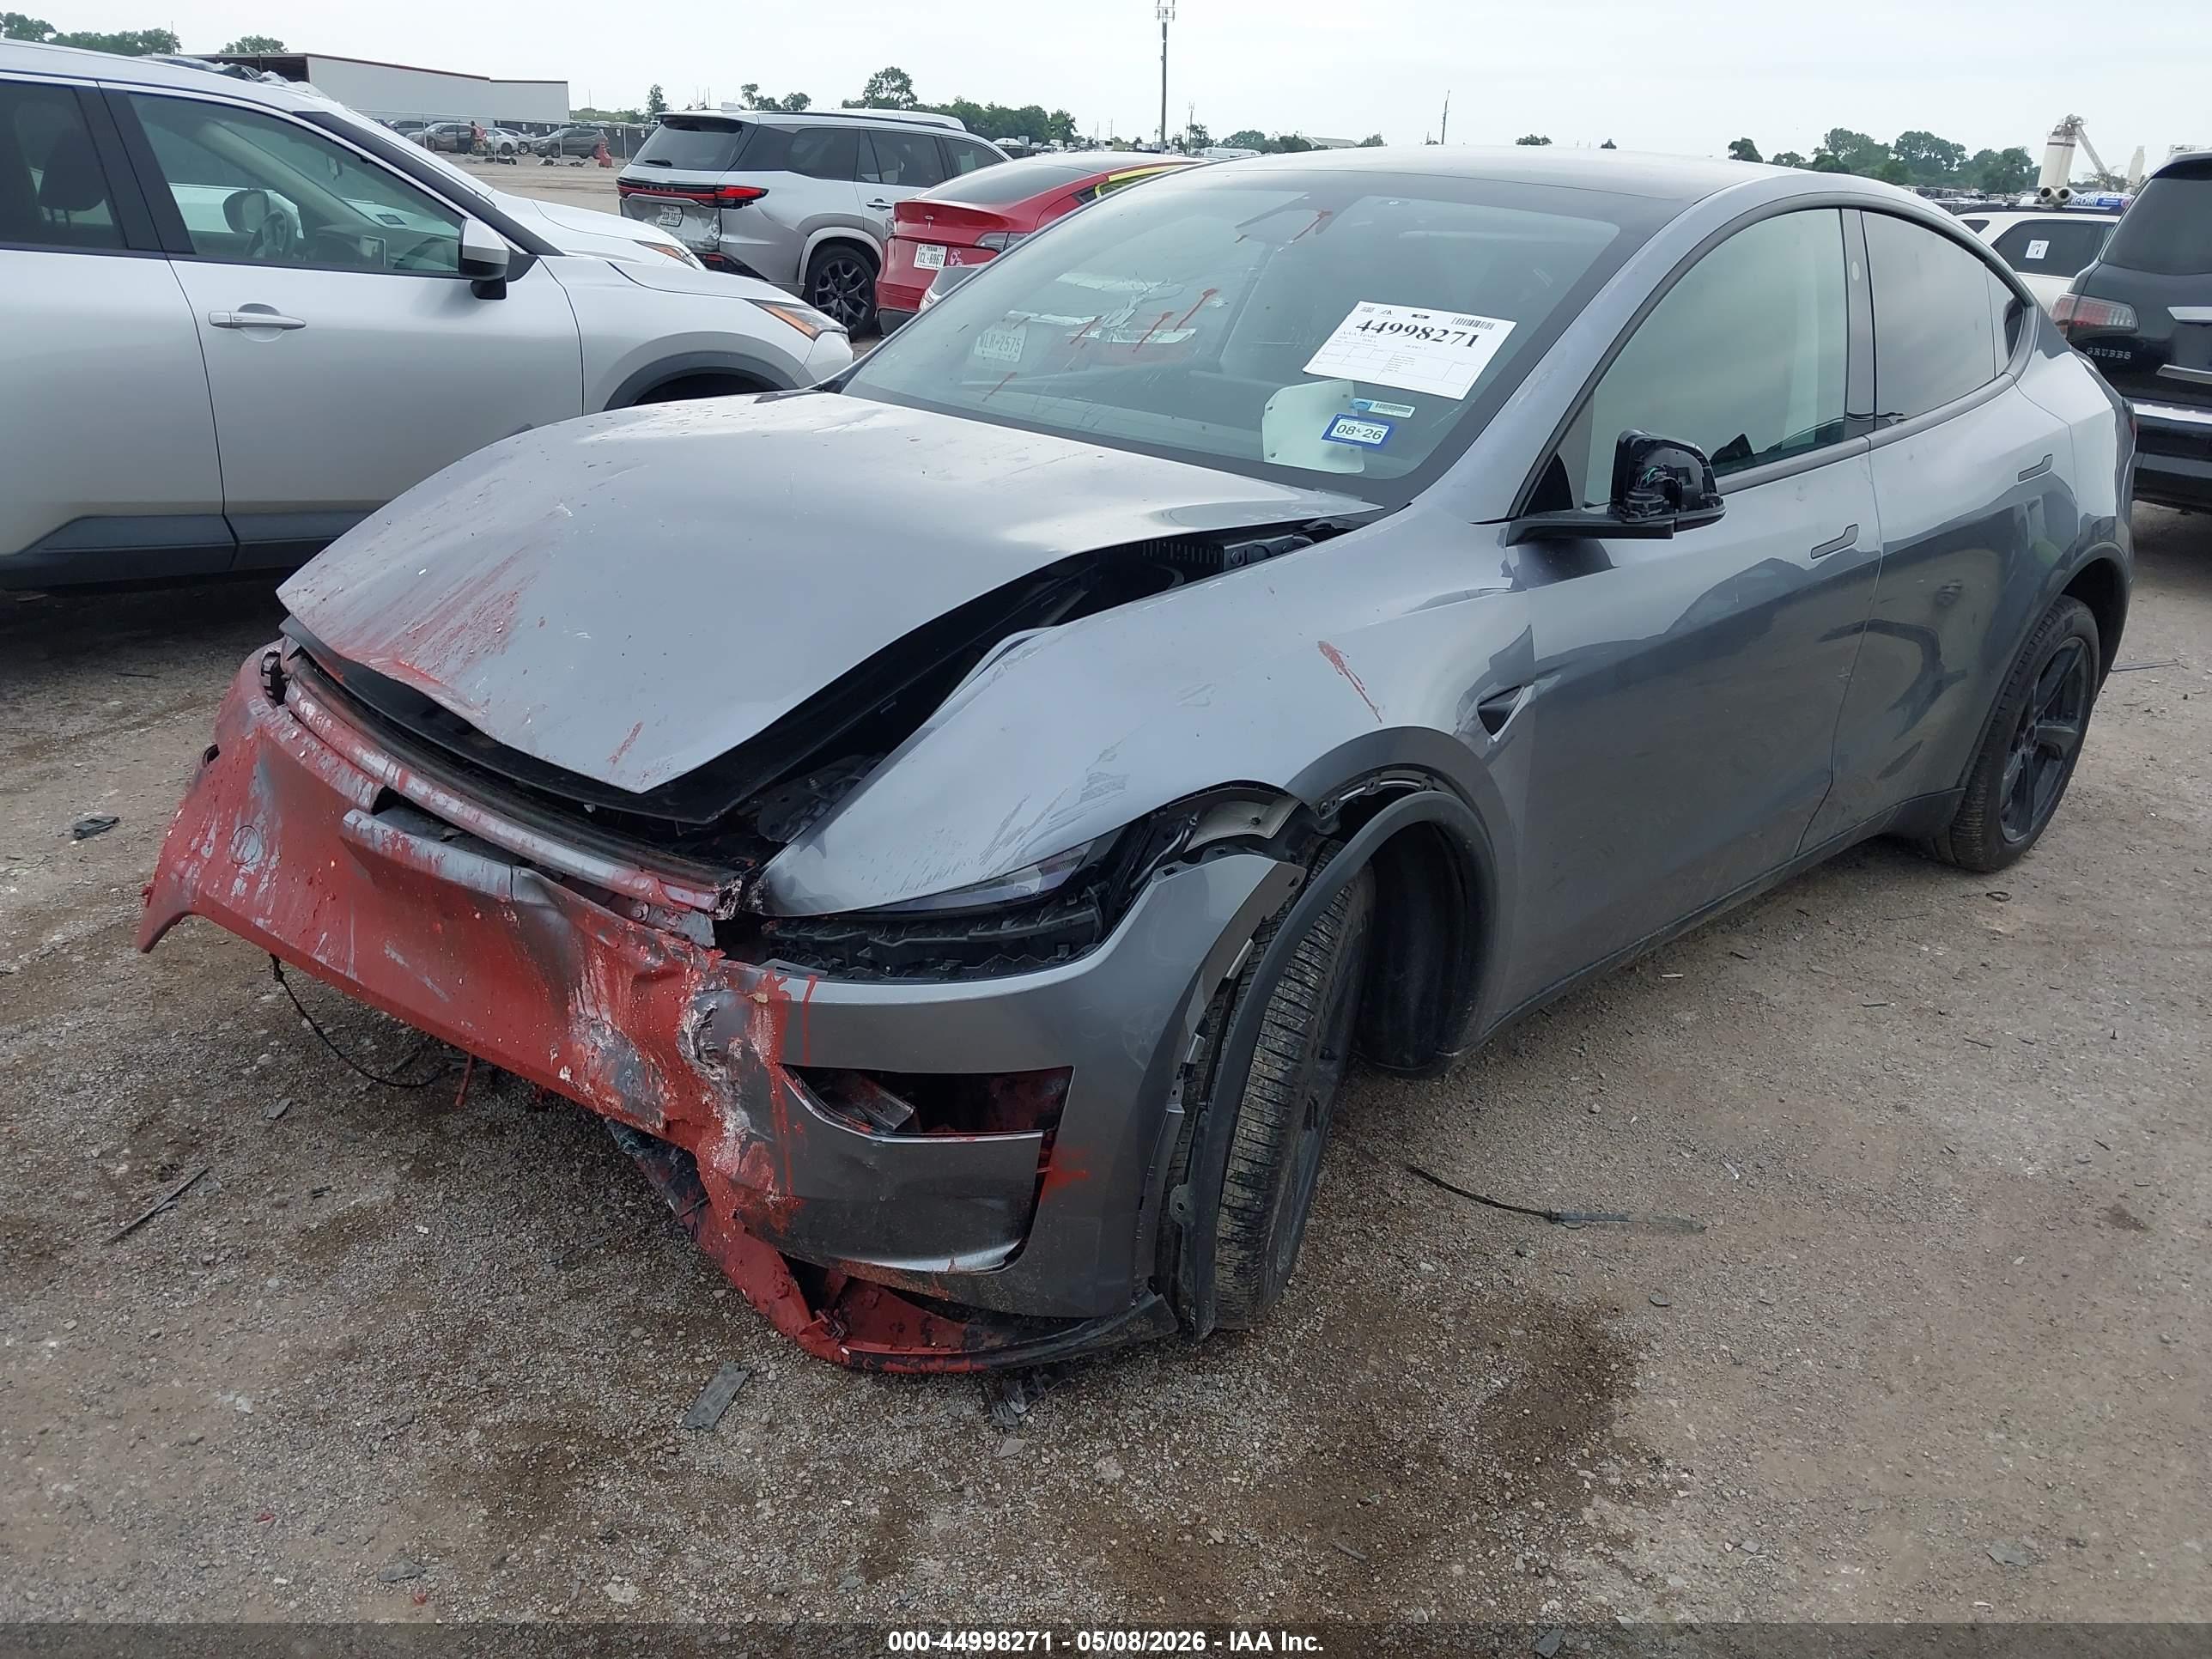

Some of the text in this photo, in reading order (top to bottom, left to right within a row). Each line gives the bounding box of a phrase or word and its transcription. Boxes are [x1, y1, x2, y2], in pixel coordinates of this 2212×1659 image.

[1356, 319, 1481, 348] 44998271
[1336, 424, 1384, 441] 08 26
